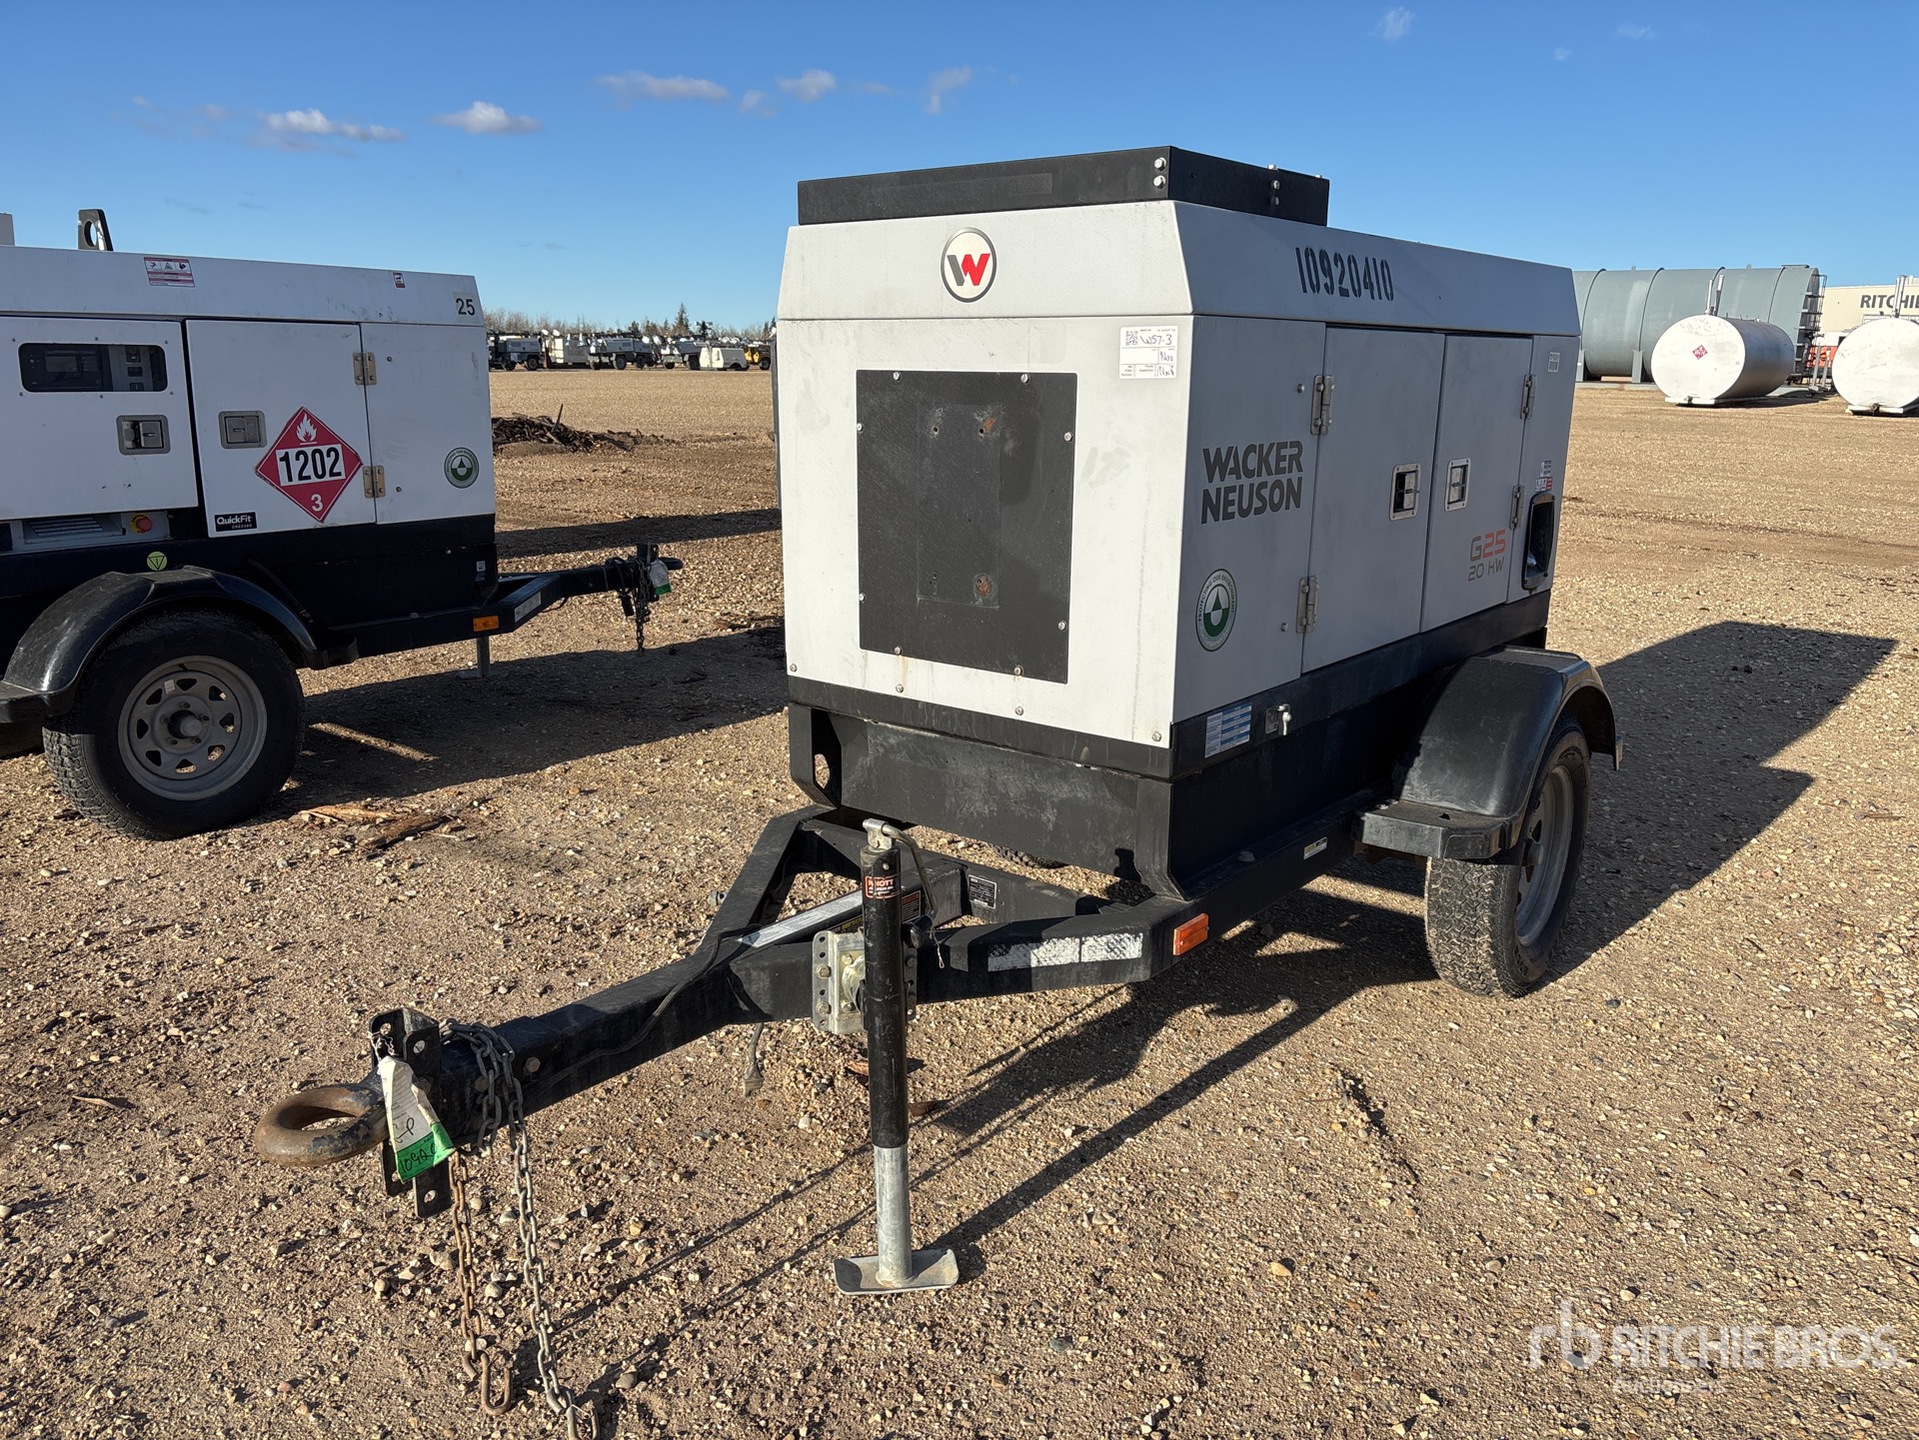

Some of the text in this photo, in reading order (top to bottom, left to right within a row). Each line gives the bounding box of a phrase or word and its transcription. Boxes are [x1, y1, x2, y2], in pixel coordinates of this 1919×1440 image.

[1295, 247, 1394, 301] 10920410
[455, 297, 476, 316] 25
[278, 446, 342, 483] 1202
[1202, 440, 1304, 484] WACKER
[310, 493, 325, 512] 3
[1200, 476, 1303, 525] NEUSON
[216, 514, 253, 526] QuickFit
[1470, 529, 1506, 562] G25
[1467, 562, 1485, 582] 20
